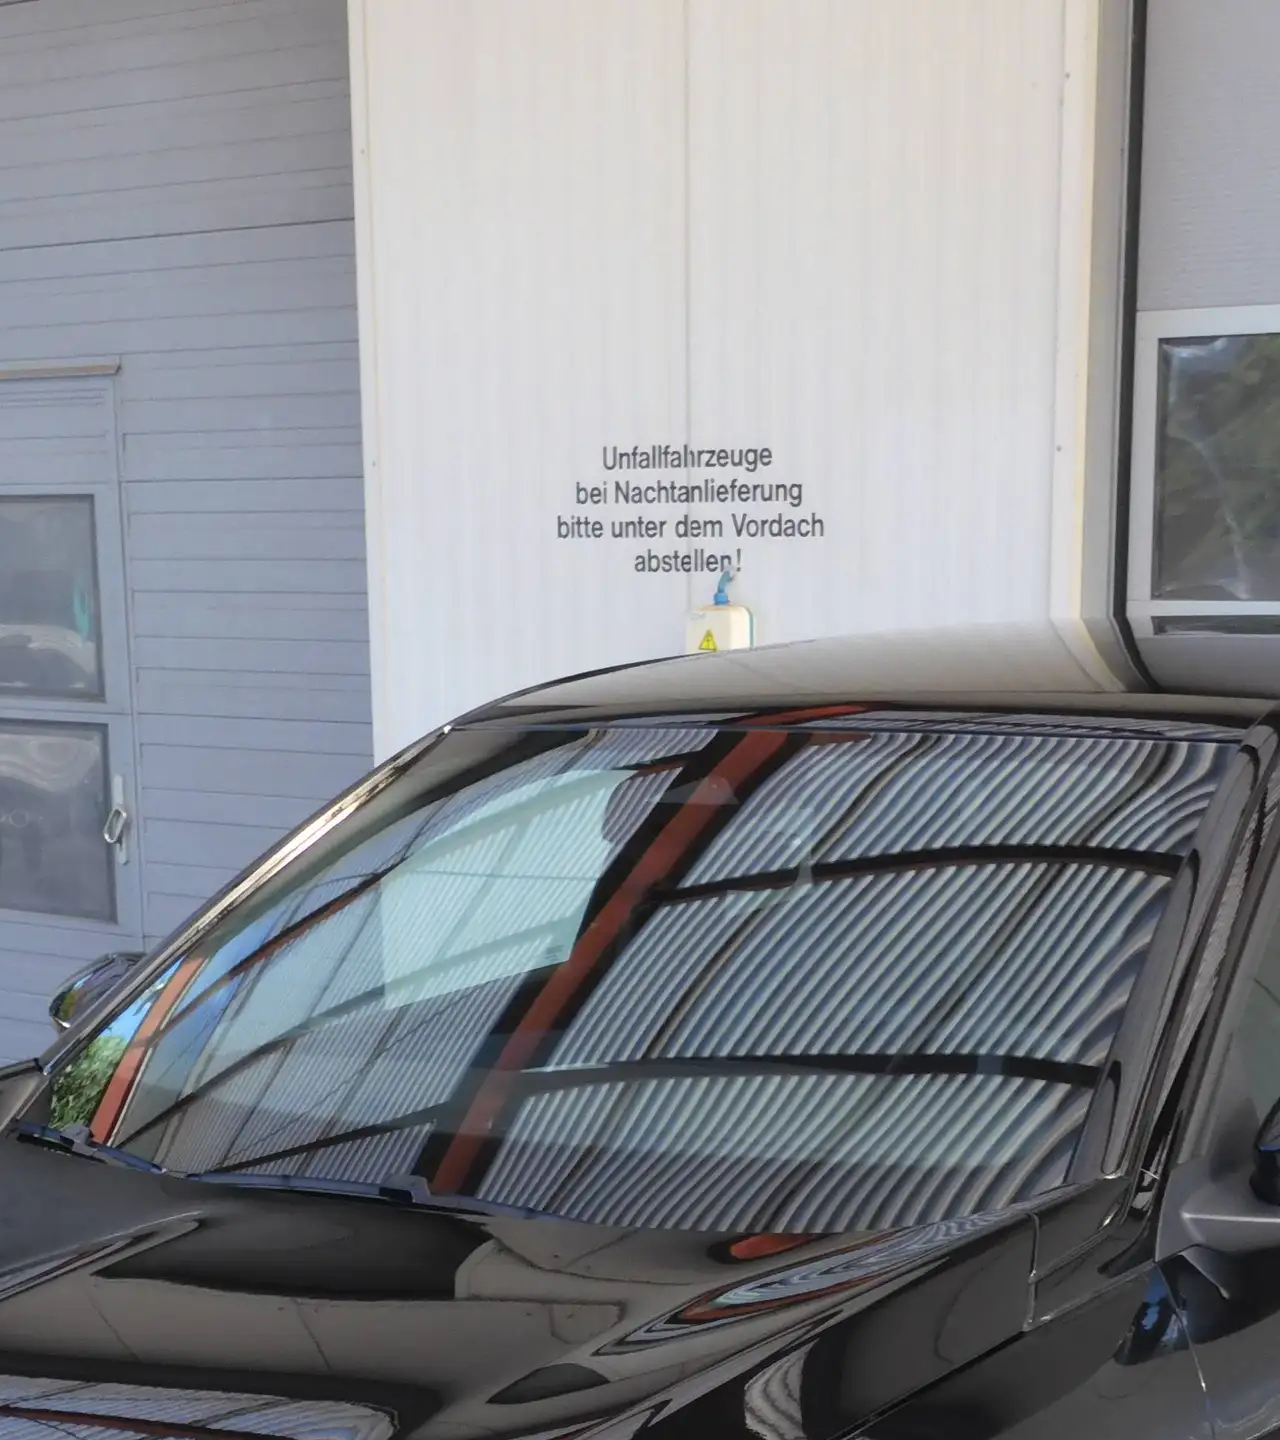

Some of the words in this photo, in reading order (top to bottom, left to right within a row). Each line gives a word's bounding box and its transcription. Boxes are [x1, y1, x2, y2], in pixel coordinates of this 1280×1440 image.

[602, 444, 773, 472] Unfallfahrzeuge
[576, 480, 607, 504] bei
[614, 477, 803, 507] Nachtanlieferung
[557, 515, 604, 539] bitte
[611, 516, 667, 538] unter
[675, 514, 723, 537] dem
[731, 512, 825, 538] Vordach
